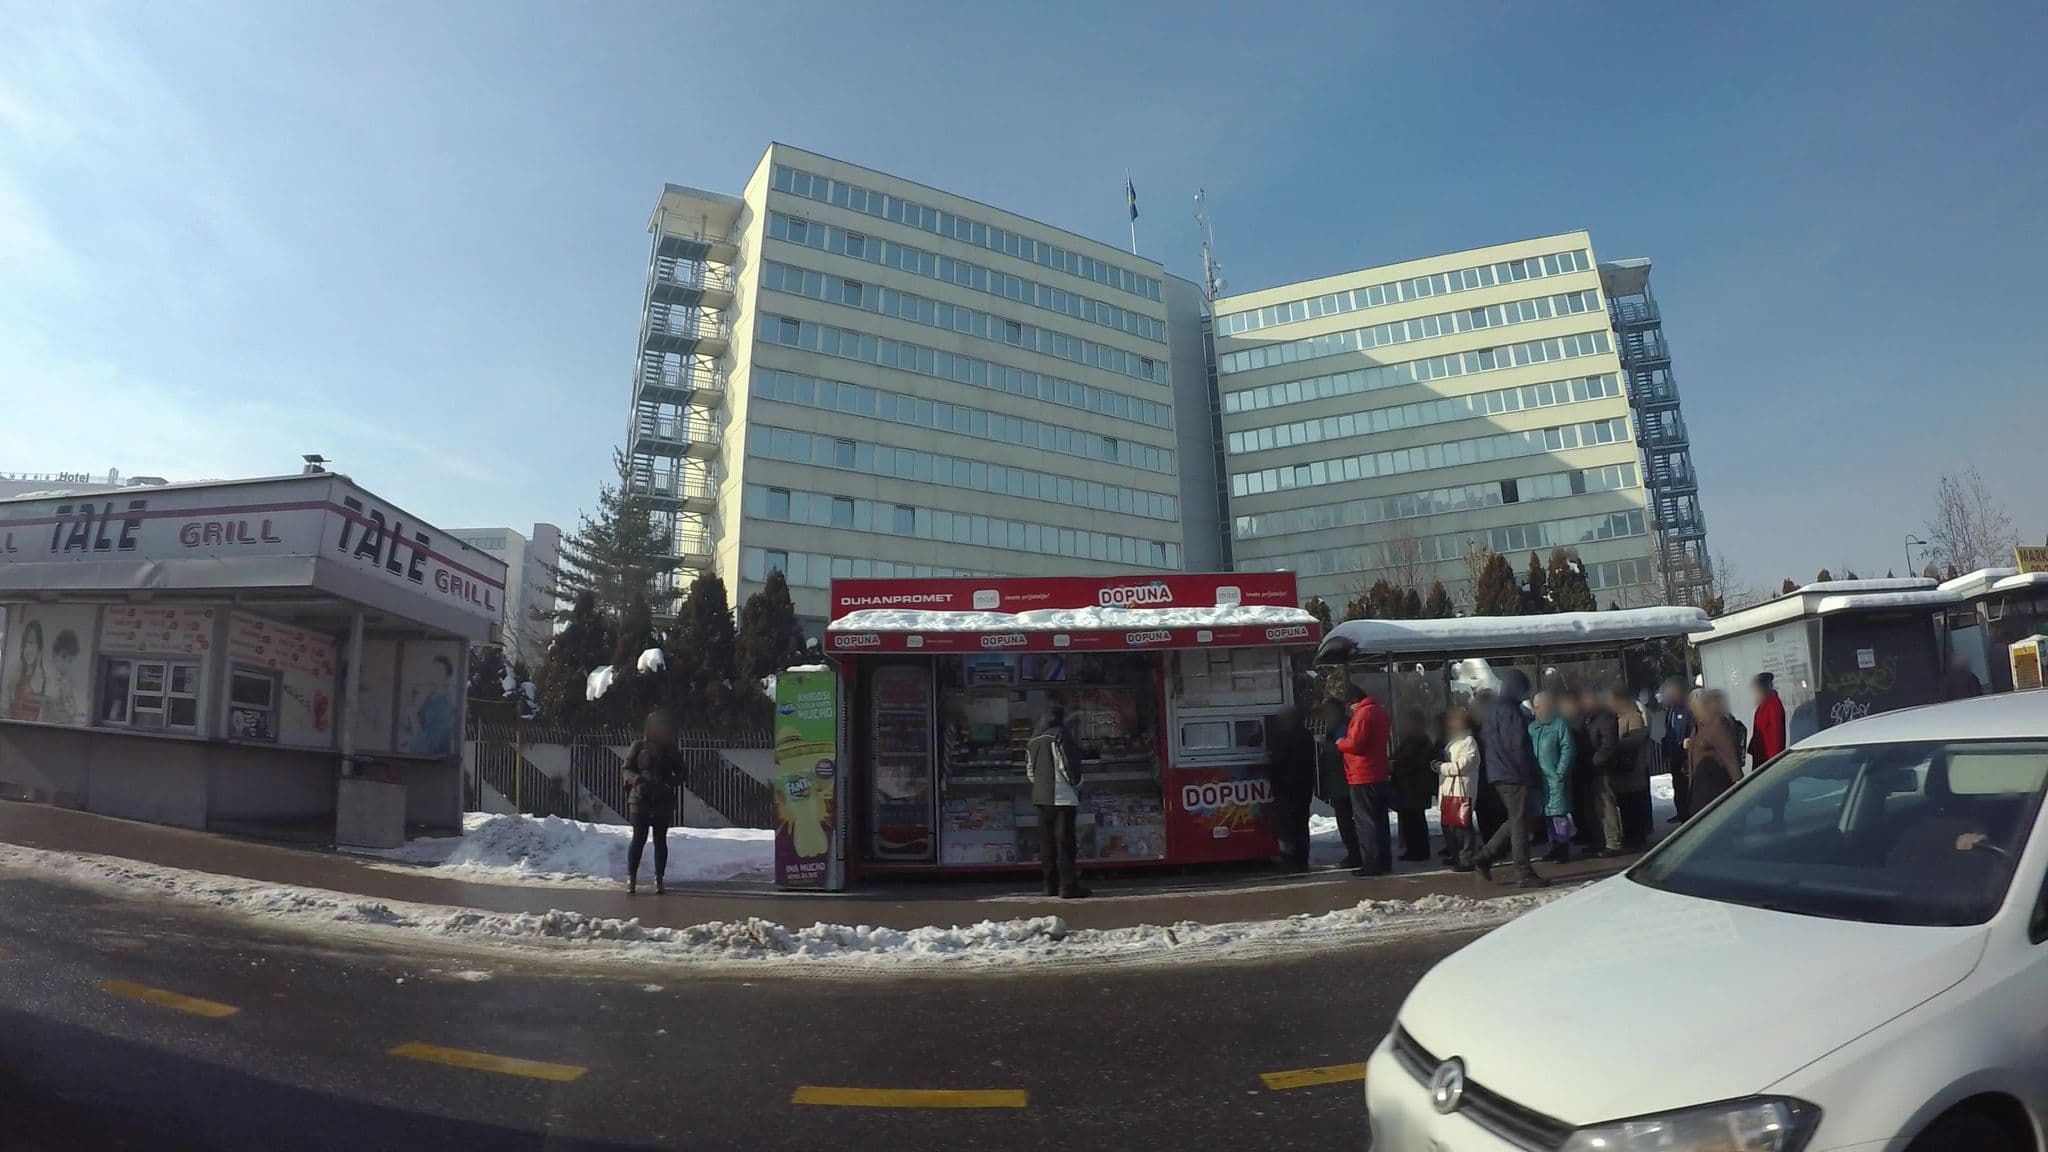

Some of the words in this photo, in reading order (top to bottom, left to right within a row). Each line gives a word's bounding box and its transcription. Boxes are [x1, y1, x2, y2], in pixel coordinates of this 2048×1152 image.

[60, 471, 90, 483] Hotel
[0, 532, 18, 553] L
[51, 500, 146, 553] TALE
[180, 519, 282, 547] GRILL
[338, 495, 430, 585] TALE
[434, 568, 496, 611] GRILL
[841, 593, 954, 606] DUHANPROMET
[1100, 586, 1171, 605] DOPUNA
[1127, 632, 1170, 643] DOPUNA
[1267, 627, 1308, 639] DOPUNA
[835, 635, 880, 647] DOPUNA
[982, 635, 1026, 647] DOPUNA
